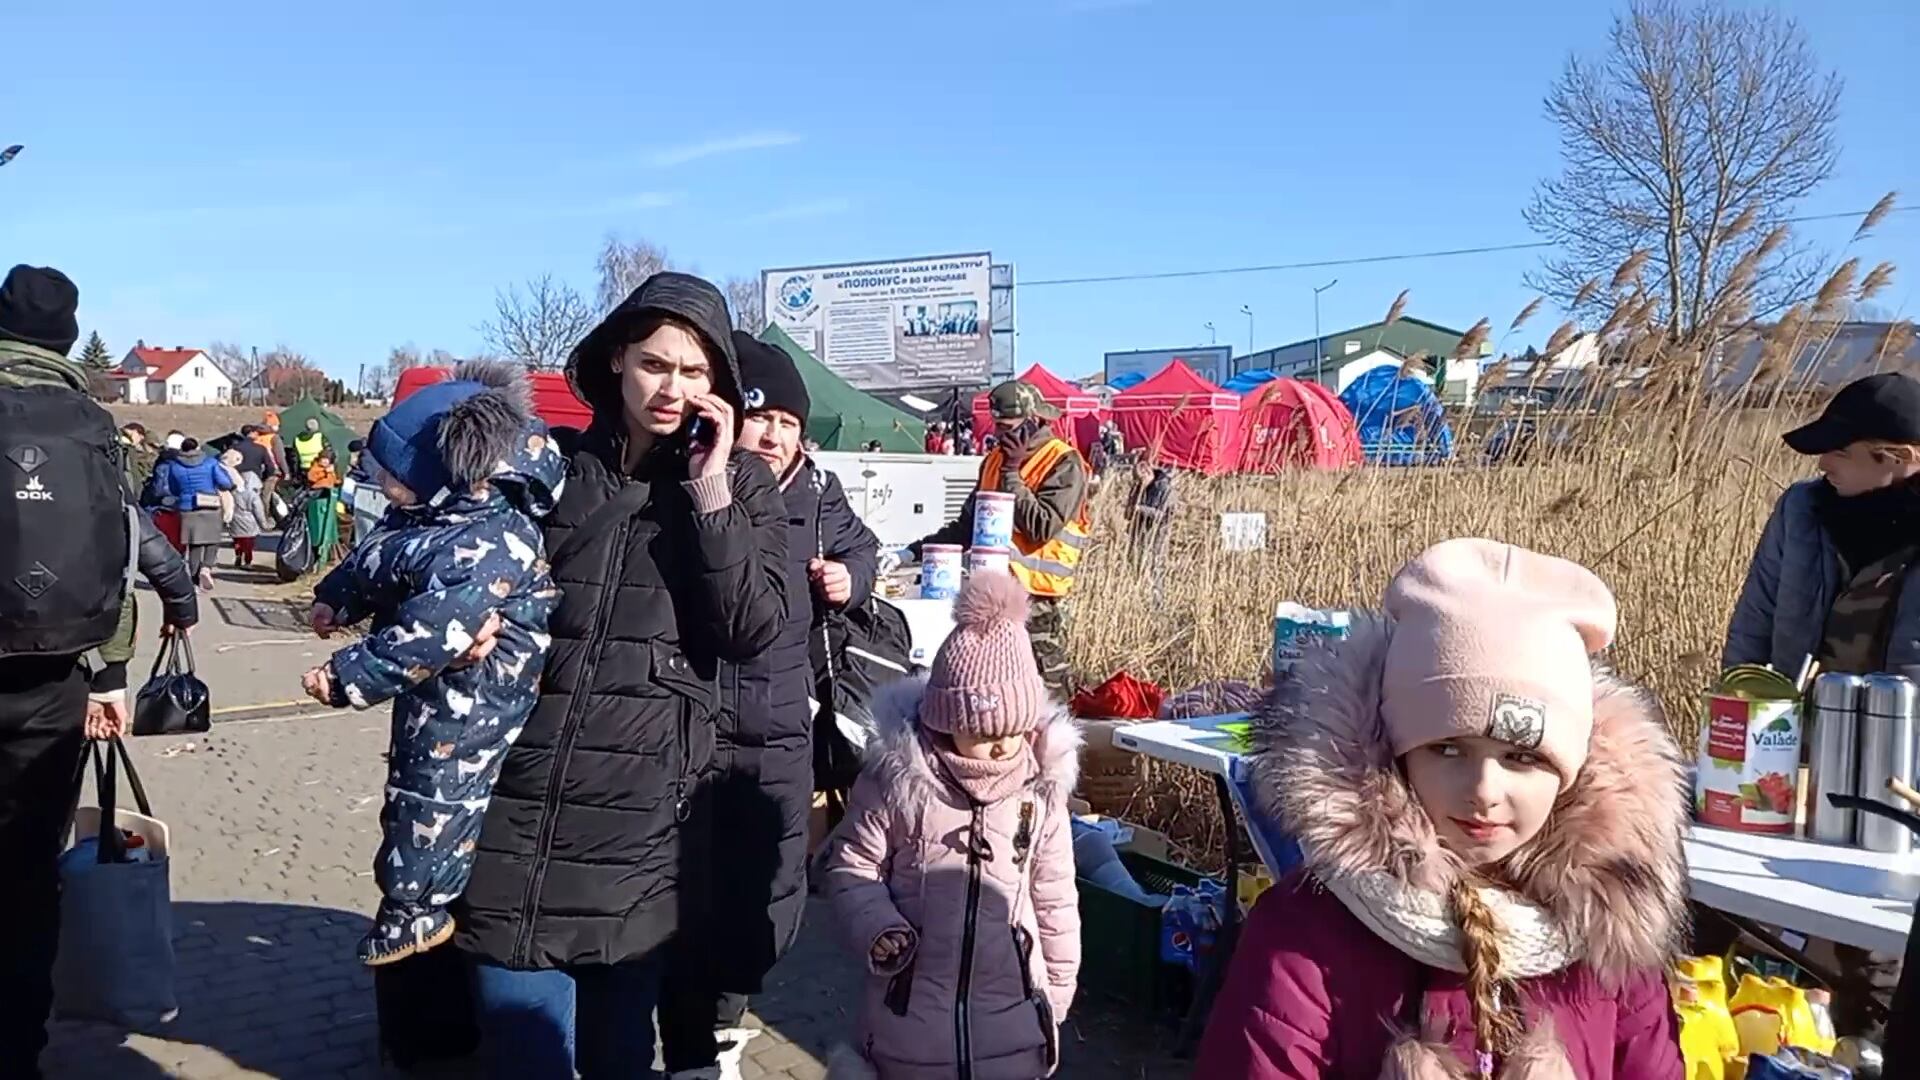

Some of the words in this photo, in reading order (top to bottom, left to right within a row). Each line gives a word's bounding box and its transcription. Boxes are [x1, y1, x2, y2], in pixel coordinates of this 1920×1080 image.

[823, 271, 850, 280] ШКОЛА
[852, 267, 899, 277] ПОЛЬСКОГО
[902, 265, 929, 274] ЯЗЫКА
[939, 261, 983, 271] КУЛЬТУРЫ
[909, 277, 921, 285] ВО
[872, 483, 893, 506] 24/7
